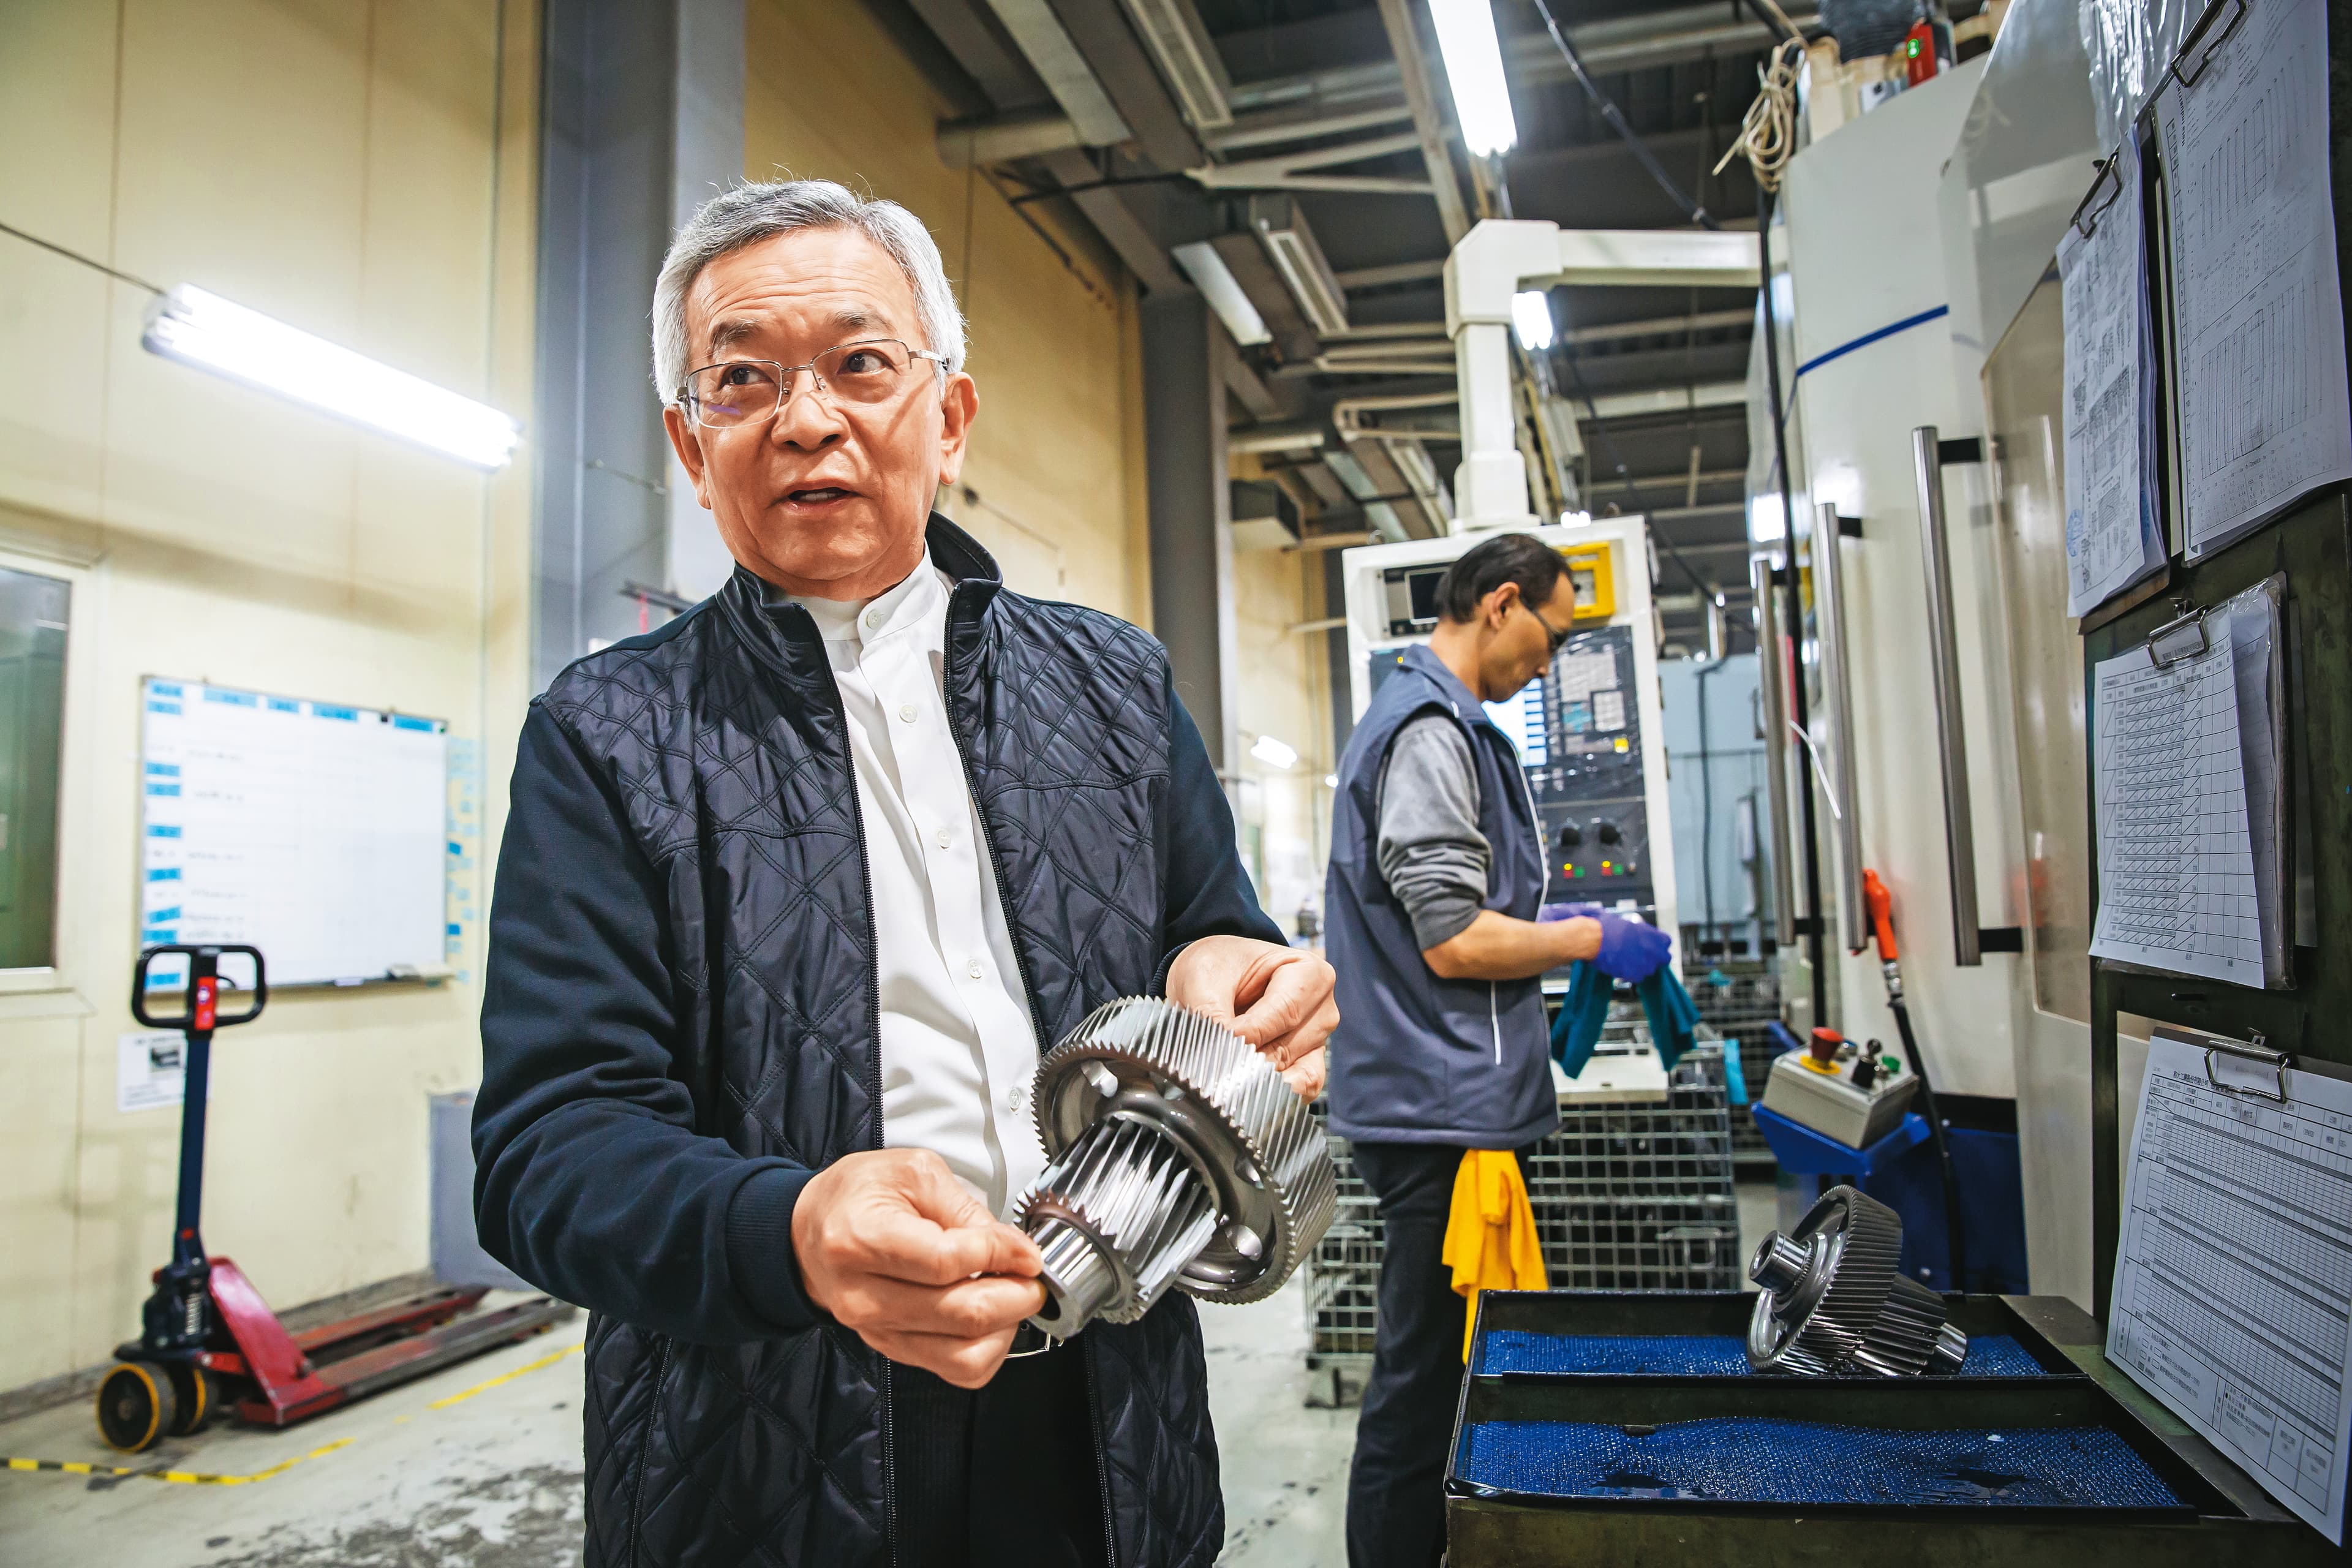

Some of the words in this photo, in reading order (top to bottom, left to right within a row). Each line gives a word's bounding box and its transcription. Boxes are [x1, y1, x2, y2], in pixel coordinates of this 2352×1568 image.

[2176, 83, 2185, 125] Industrial
[2173, 1071, 2209, 1088] 和大工業股份有限公司
